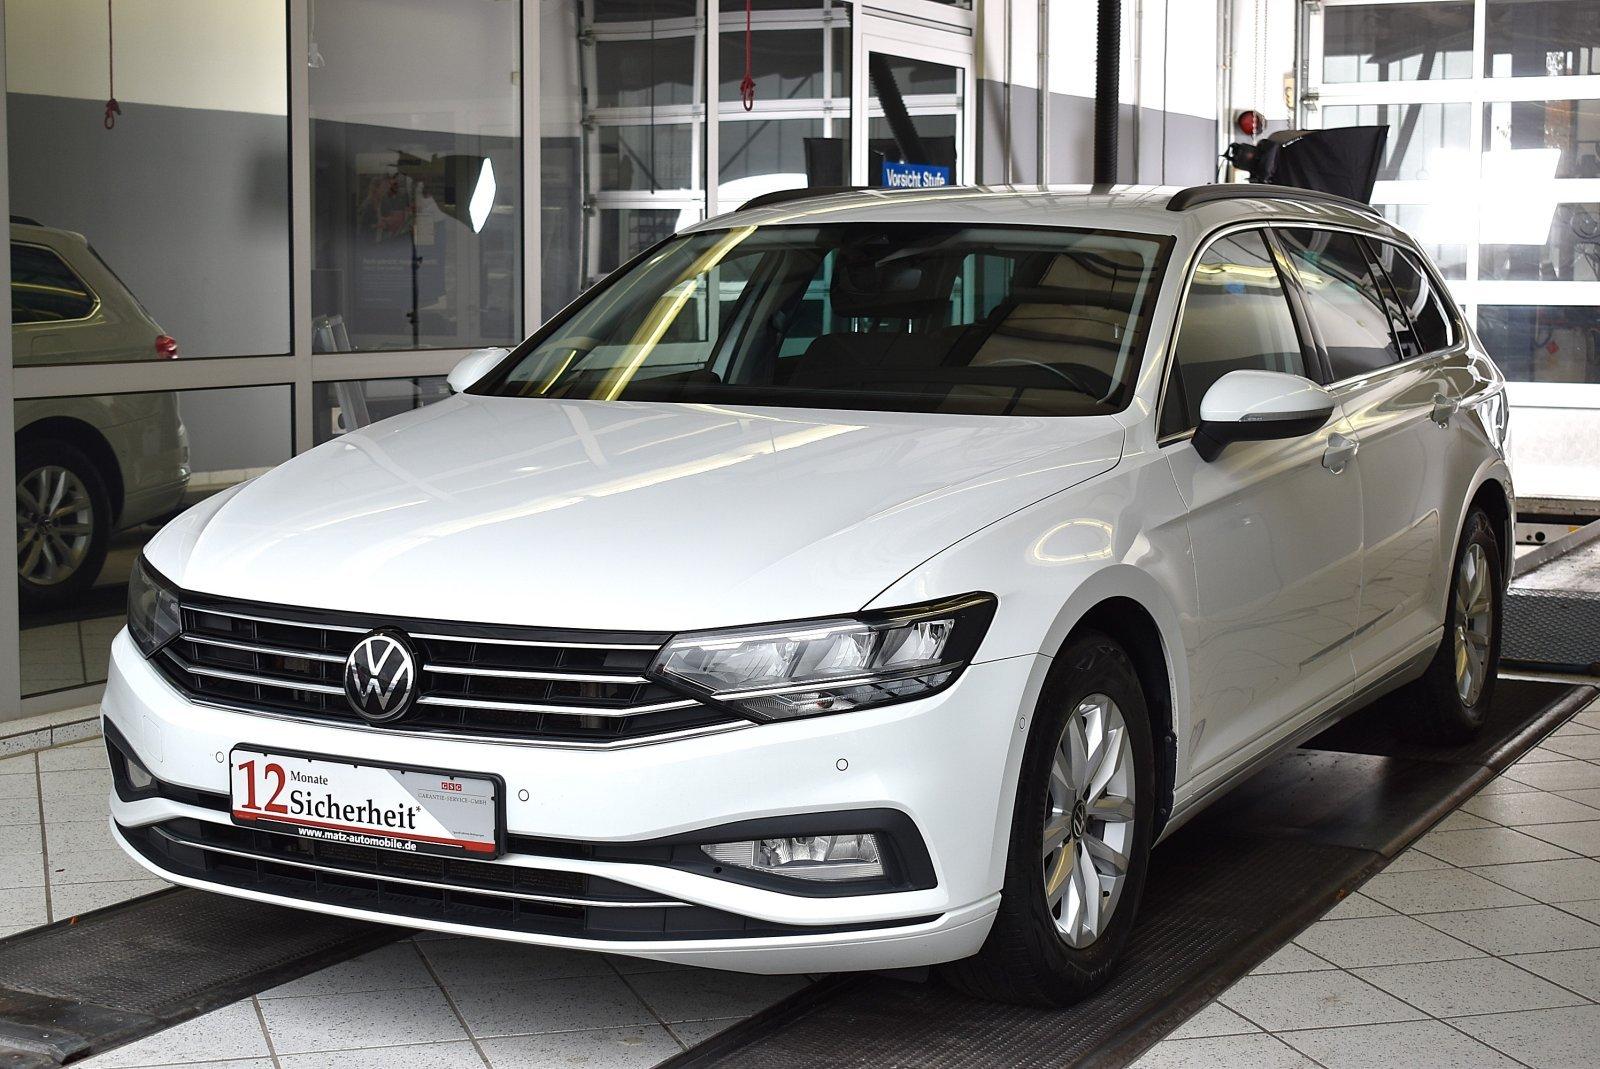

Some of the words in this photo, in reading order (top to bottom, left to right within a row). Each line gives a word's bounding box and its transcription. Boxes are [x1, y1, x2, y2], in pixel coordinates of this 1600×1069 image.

[886, 168, 922, 187] Vorsicht
[923, 171, 946, 187] Stufe
[347, 637, 413, 716] VW
[238, 760, 288, 814] 12
[290, 770, 329, 786] Monate
[298, 828, 417, 851] www.matz-automobile.de
